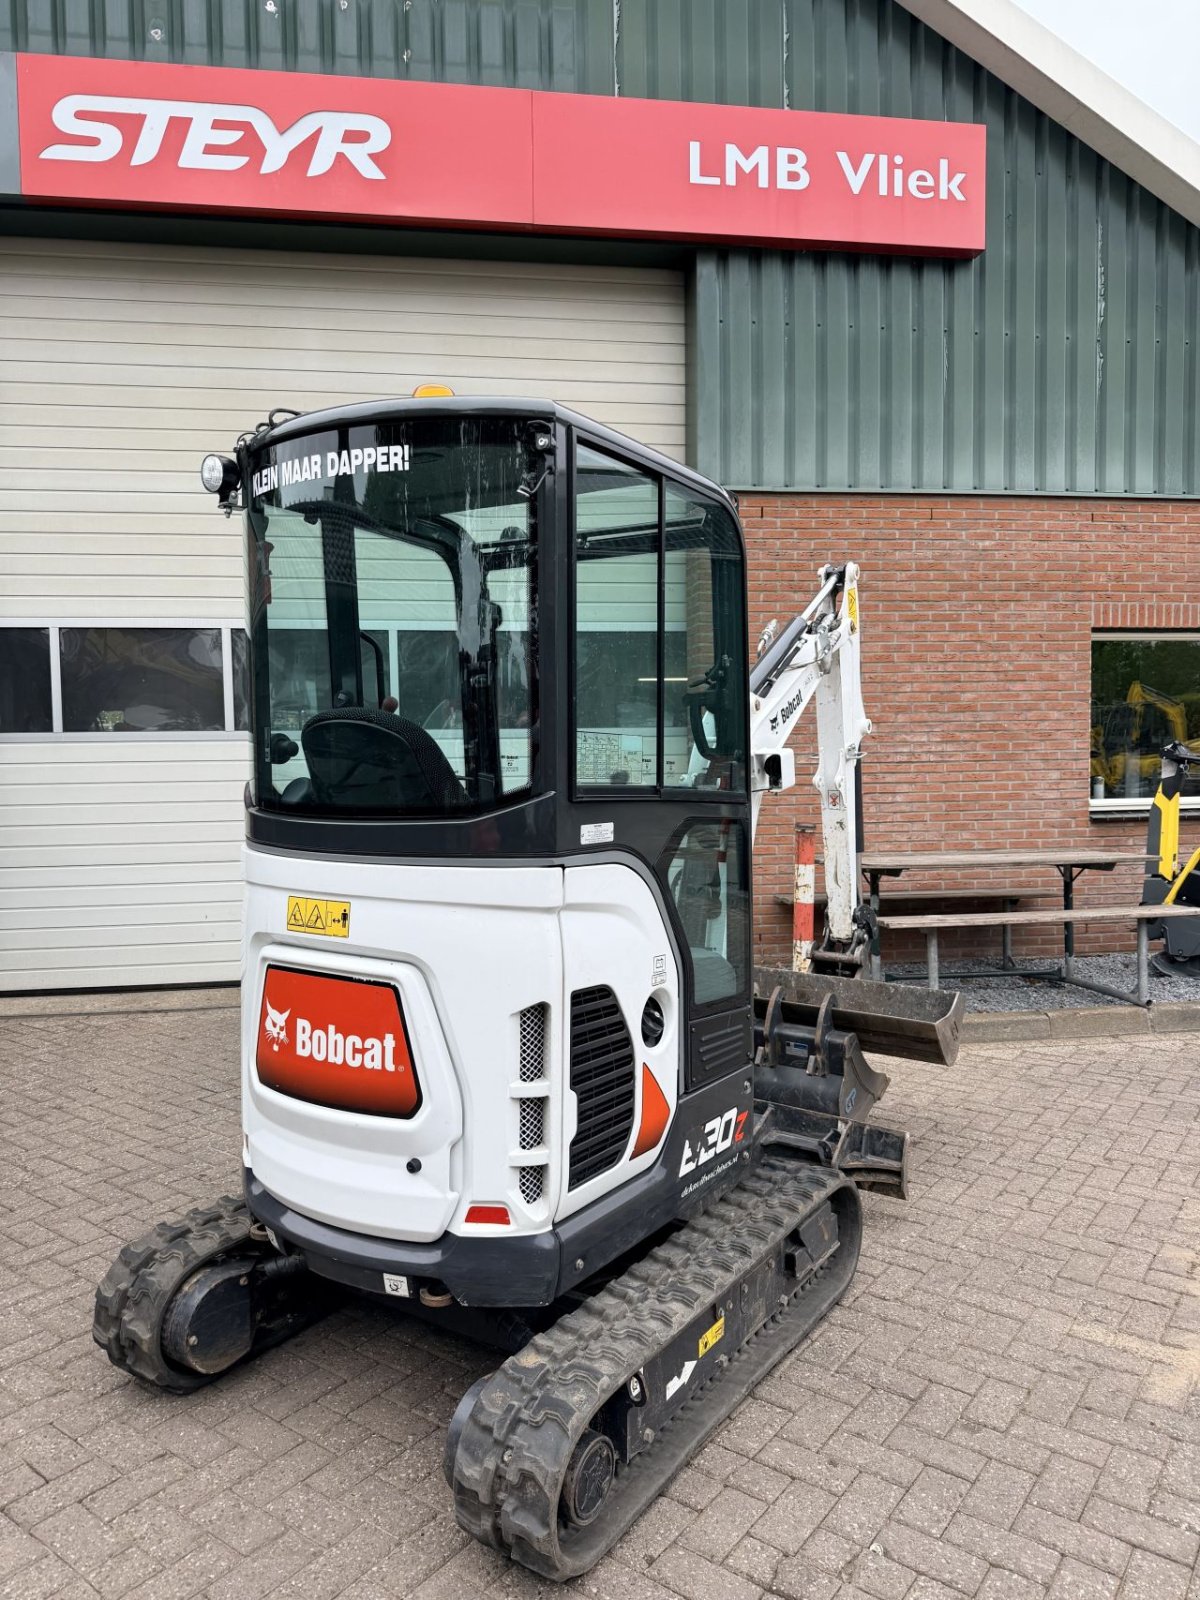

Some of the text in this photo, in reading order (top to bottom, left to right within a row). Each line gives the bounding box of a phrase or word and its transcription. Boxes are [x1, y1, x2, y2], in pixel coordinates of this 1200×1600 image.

[39, 94, 392, 180] STEYR
[689, 140, 967, 201] LMB Vliek
[252, 444, 410, 498] KLEIN MAAR DAPPER!
[780, 688, 803, 725] Bobcat
[296, 1017, 396, 1072] Bobcat
